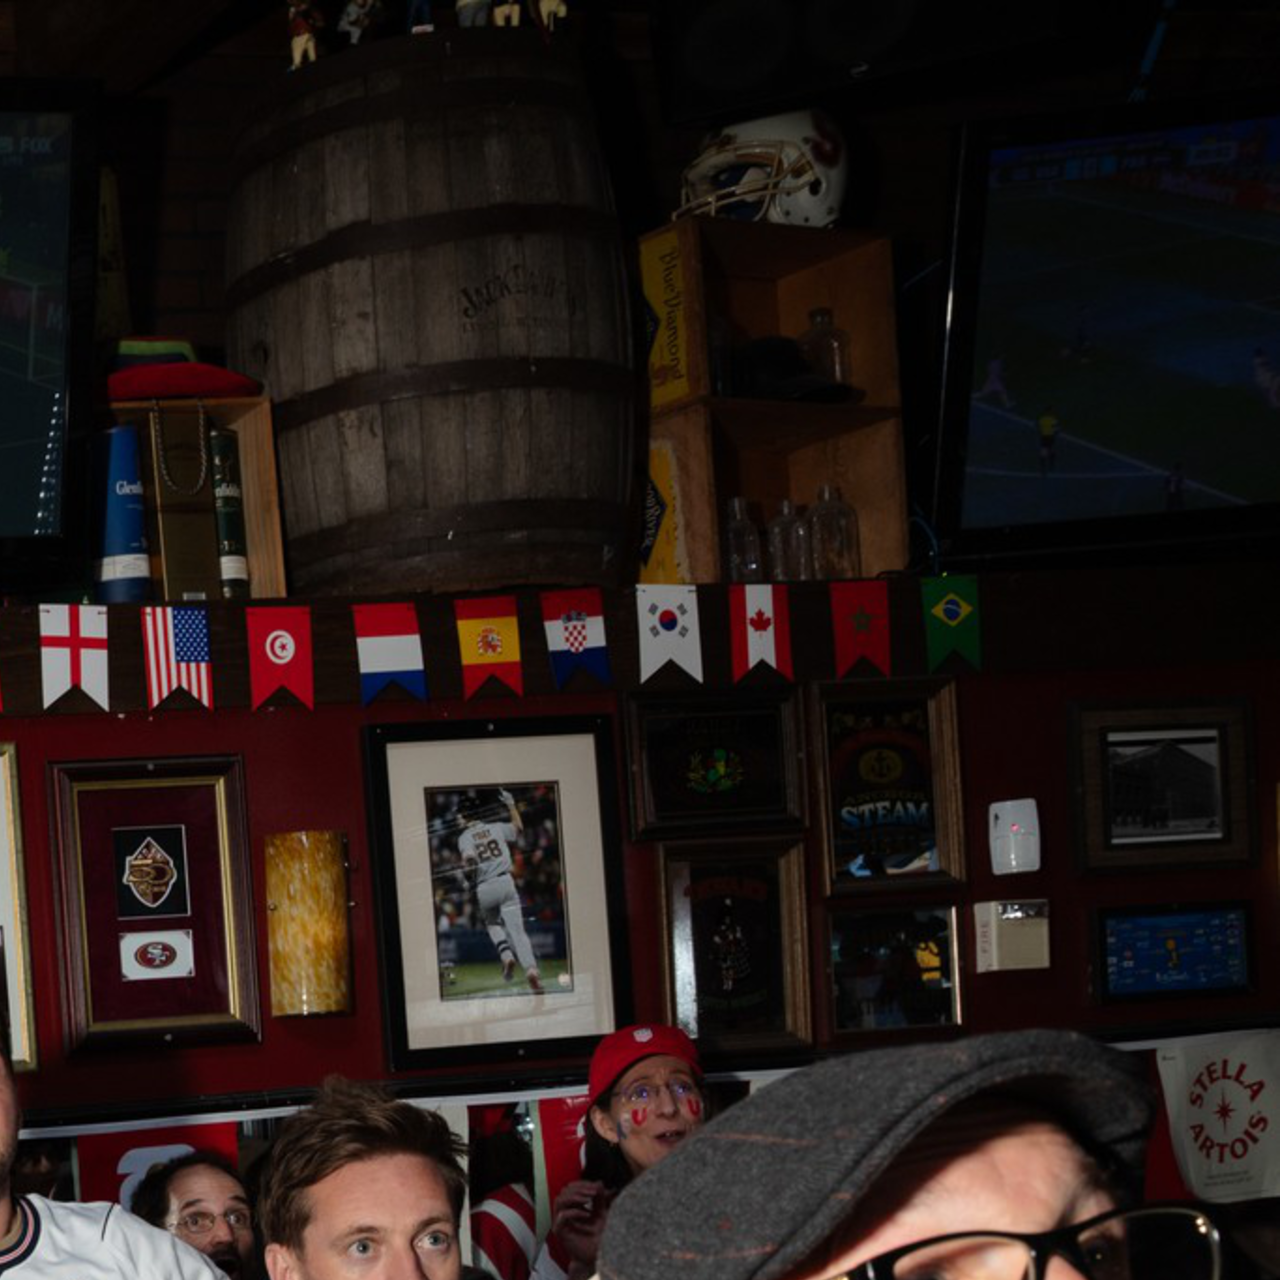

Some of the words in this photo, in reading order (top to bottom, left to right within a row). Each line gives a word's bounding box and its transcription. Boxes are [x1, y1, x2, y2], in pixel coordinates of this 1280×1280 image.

[19, 135, 52, 154] FOX
[840, 801, 931, 830] STEAM
[474, 839, 503, 863] 28
[1191, 1058, 1266, 1109] STELLA
[1190, 1113, 1269, 1164] ARTOIS
